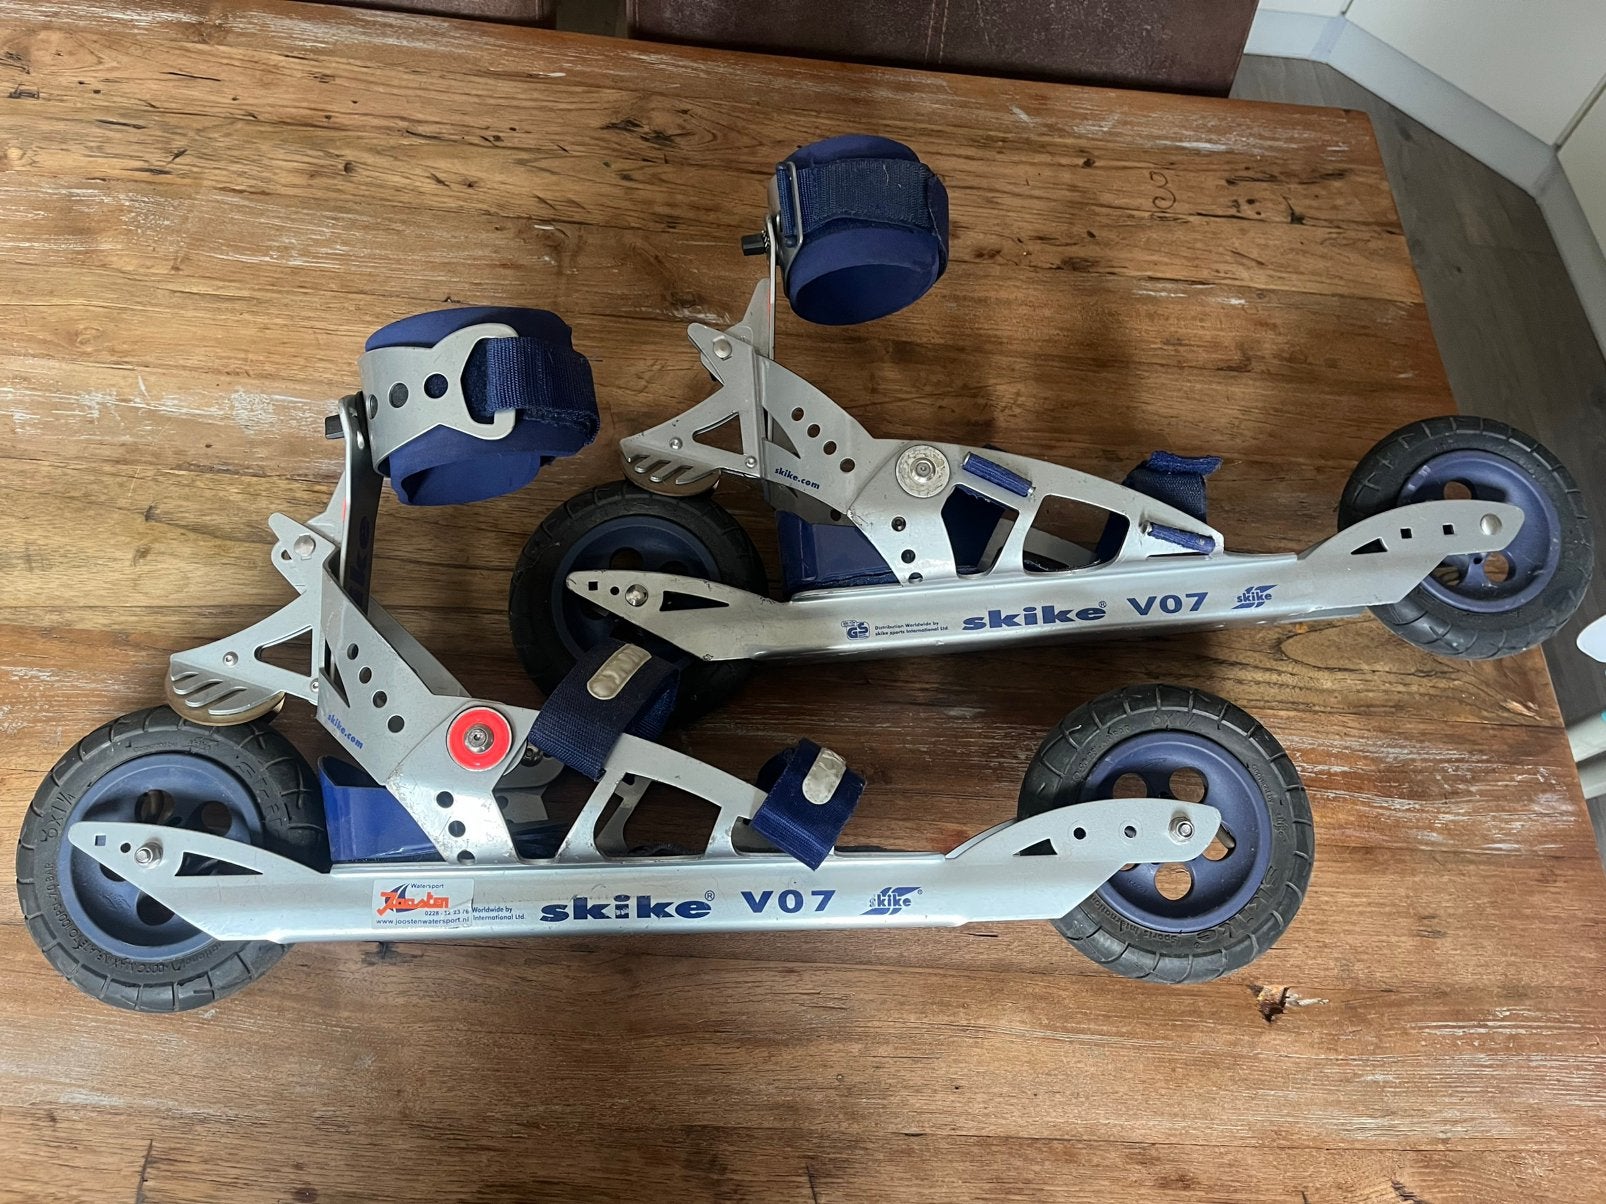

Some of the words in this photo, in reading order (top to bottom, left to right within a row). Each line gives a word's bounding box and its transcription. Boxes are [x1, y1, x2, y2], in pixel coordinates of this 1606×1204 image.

[774, 467, 820, 489] skike.com
[1126, 591, 1208, 616] V07
[1236, 591, 1272, 603] skike
[906, 626, 939, 634] International
[327, 714, 364, 749] skike.com
[472, 905, 504, 914] Worldwide
[505, 905, 513, 914] by
[740, 889, 836, 914] V07
[376, 917, 470, 925] www.joostenwatersport.nl
